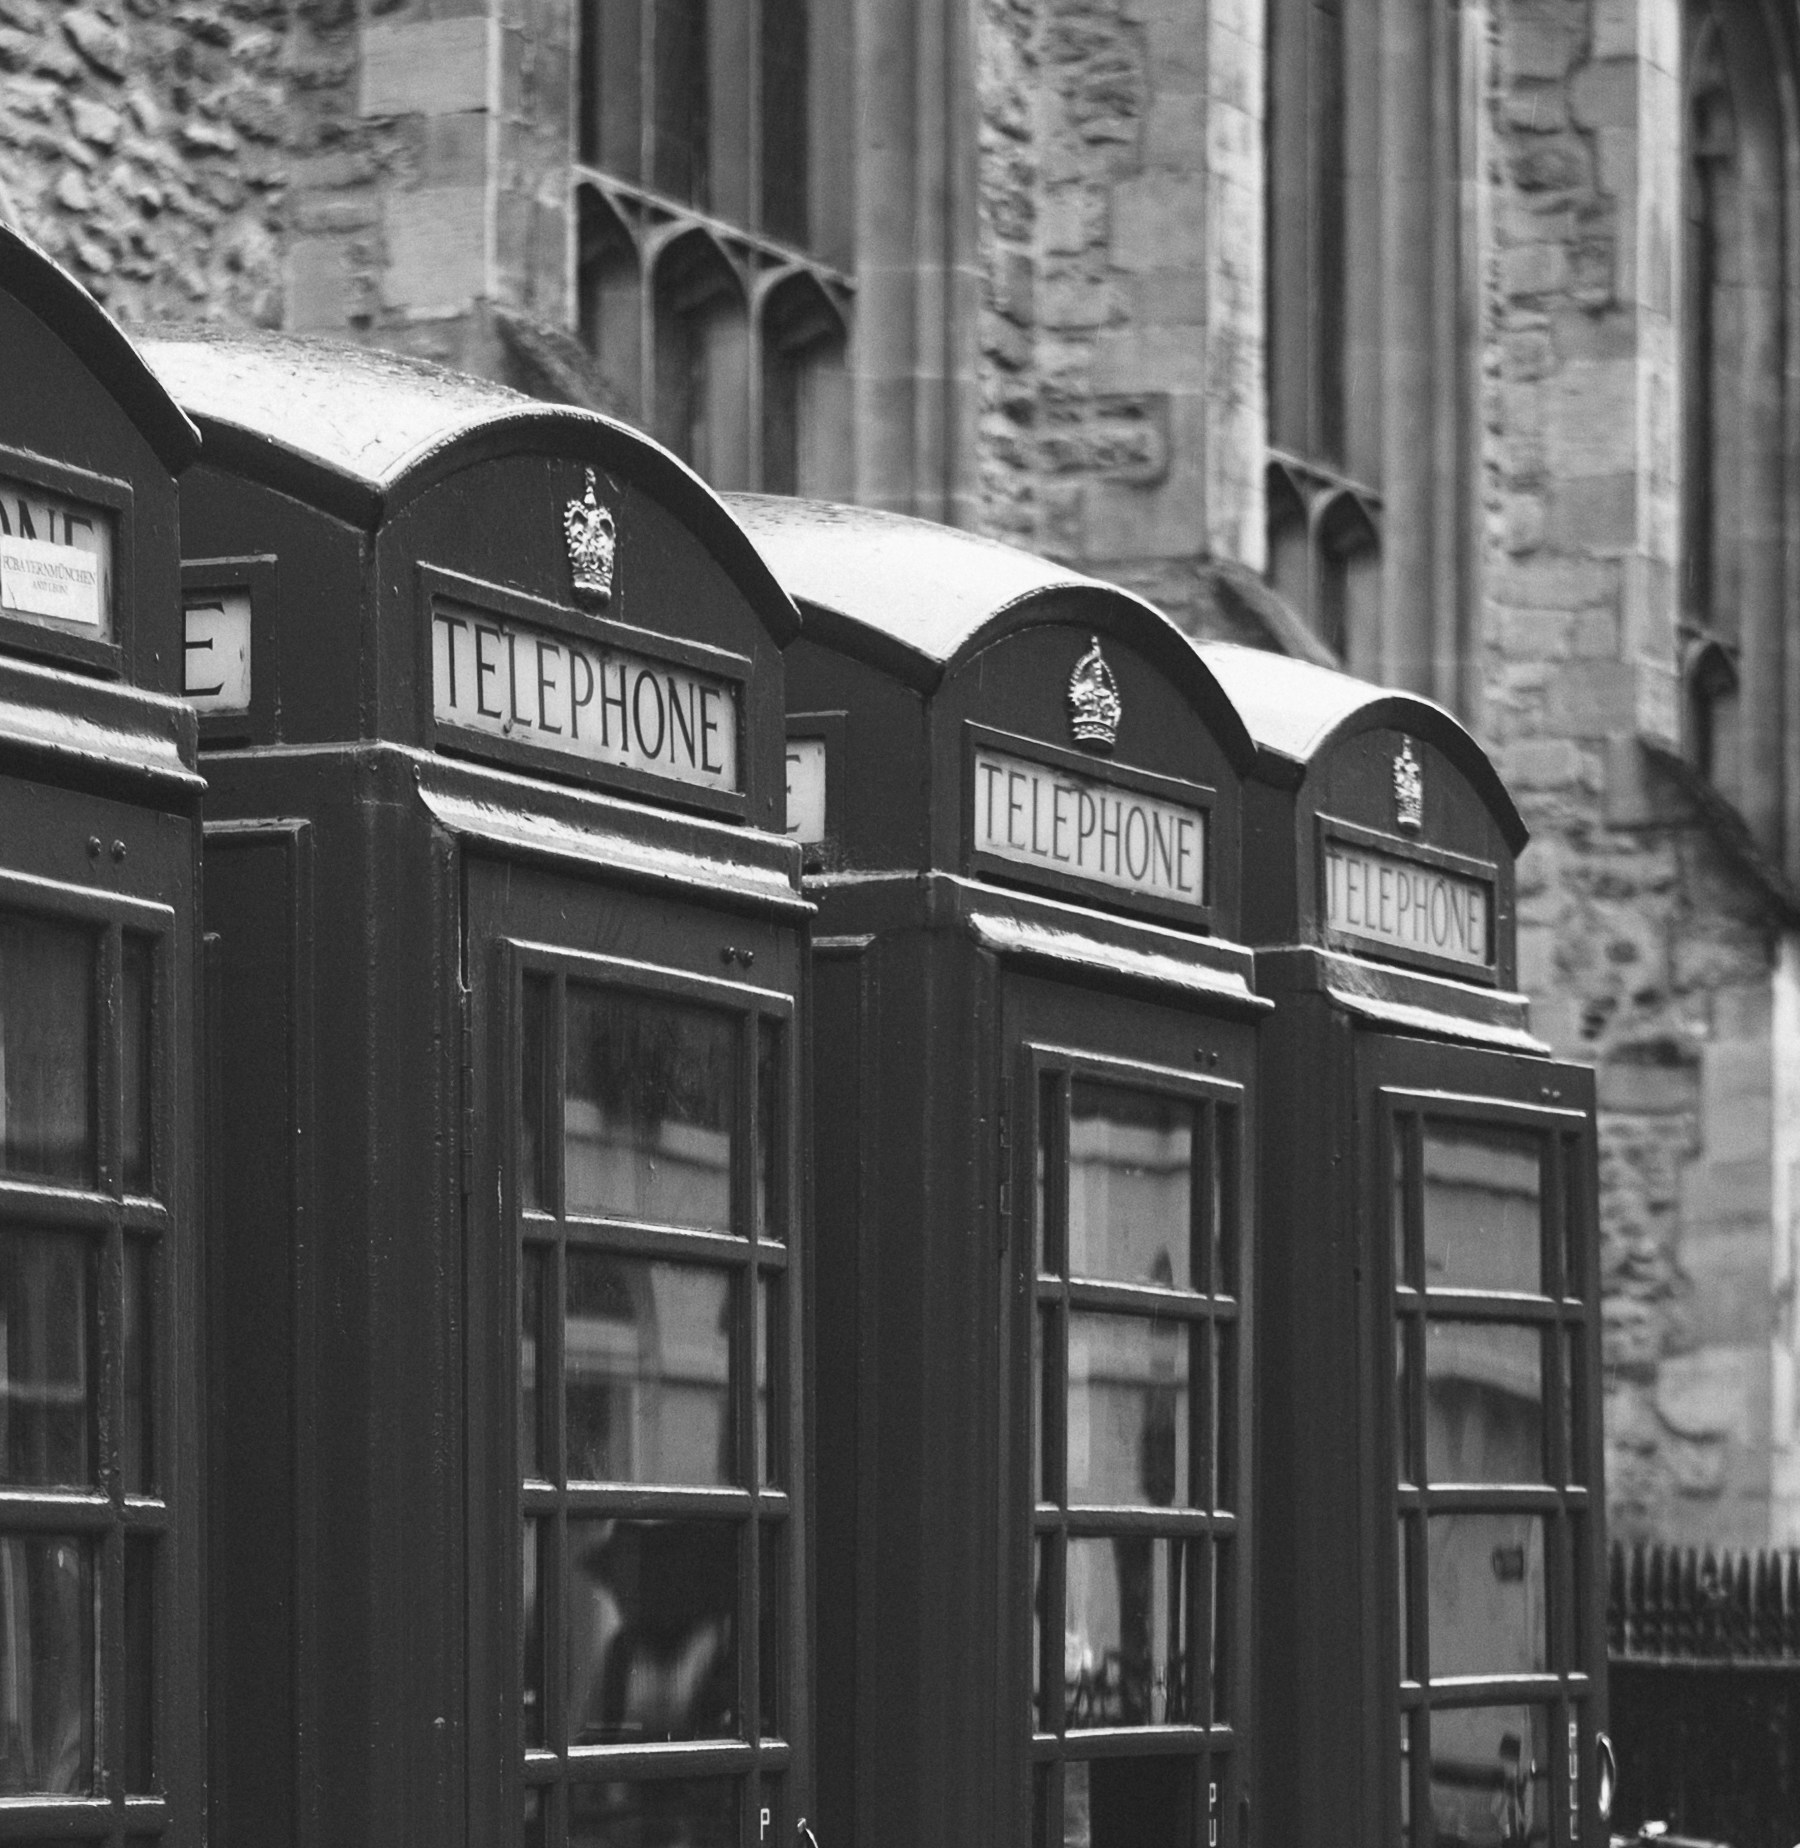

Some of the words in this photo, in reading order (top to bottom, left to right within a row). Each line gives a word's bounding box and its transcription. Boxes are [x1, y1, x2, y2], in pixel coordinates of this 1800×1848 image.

[433, 613, 724, 775] TELEPHONE
[979, 762, 1194, 893] TELEPHONE
[1326, 854, 1481, 956] TELEPHONE
[1568, 1723, 1579, 1841] PULL
